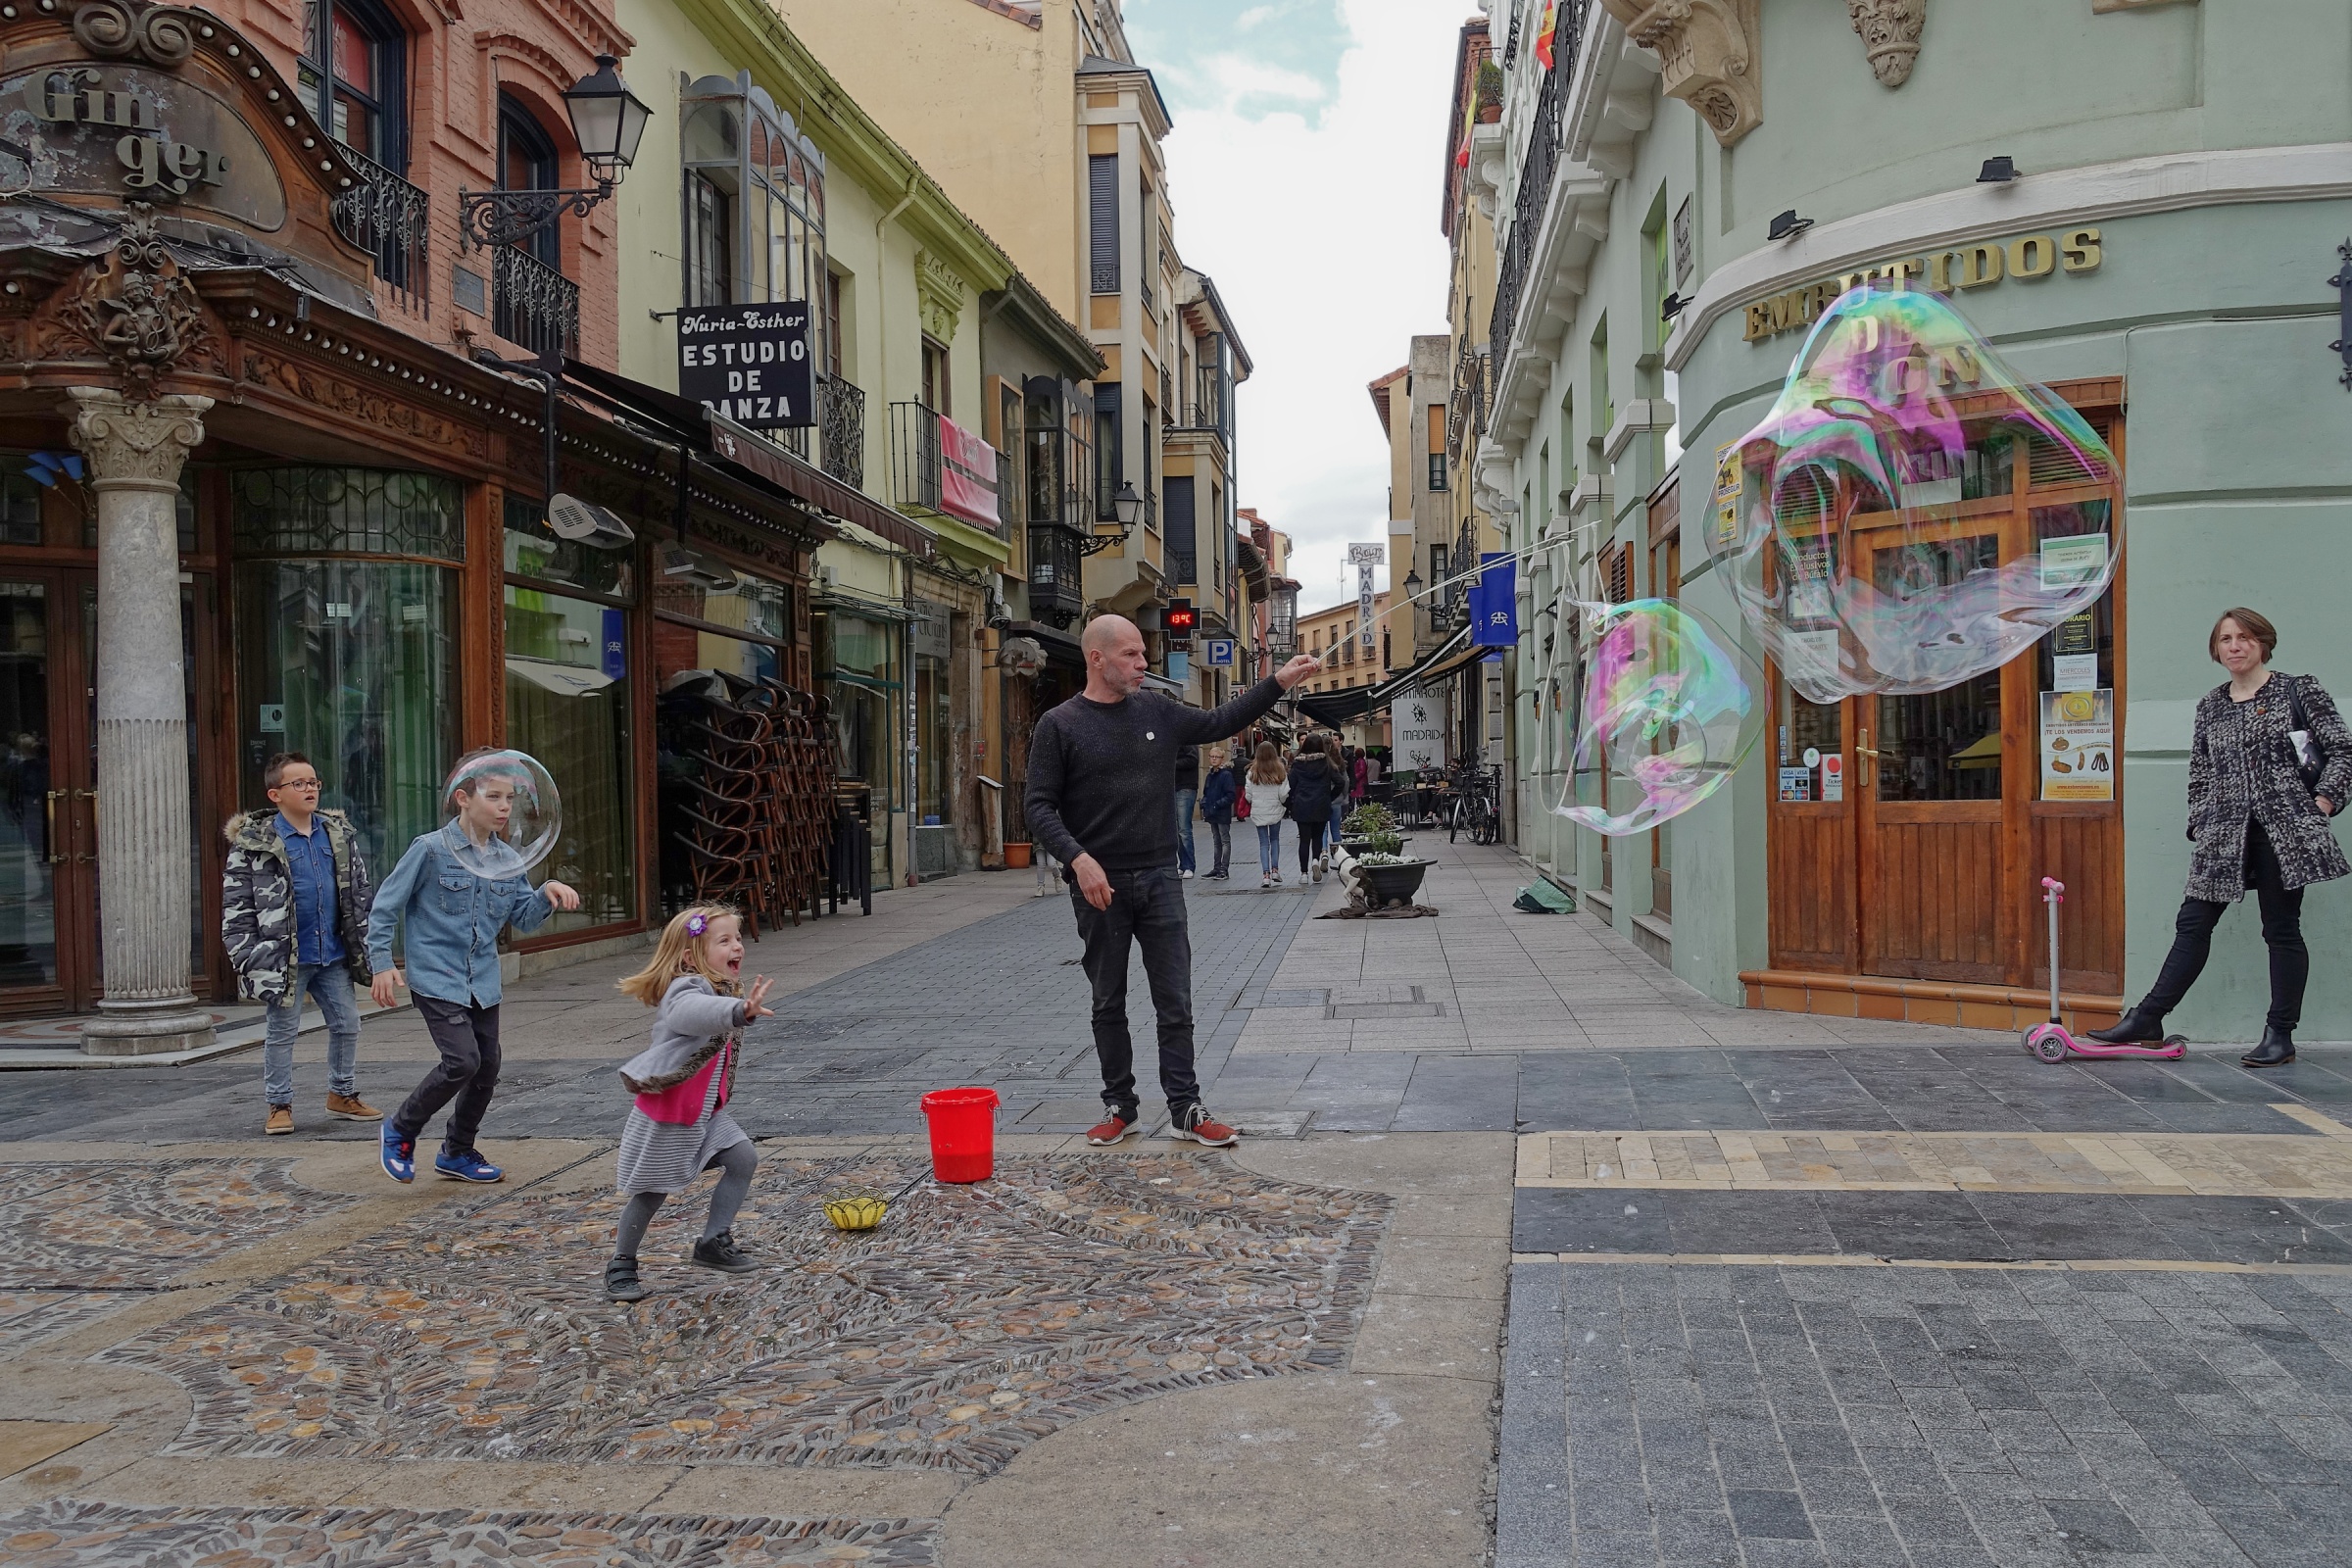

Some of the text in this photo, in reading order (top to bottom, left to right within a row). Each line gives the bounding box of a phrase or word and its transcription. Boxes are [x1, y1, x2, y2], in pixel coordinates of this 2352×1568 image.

[23, 69, 161, 131] Gin
[116, 135, 230, 194] ger
[683, 340, 805, 367] ESTUDIO
[728, 369, 761, 392] DE
[1349, 546, 1382, 563] Bar
[1360, 567, 1372, 645] MADRID
[2064, 613, 2091, 622] ORARIO
[1211, 642, 1229, 663] P
[1402, 729, 1441, 741] MADRID
